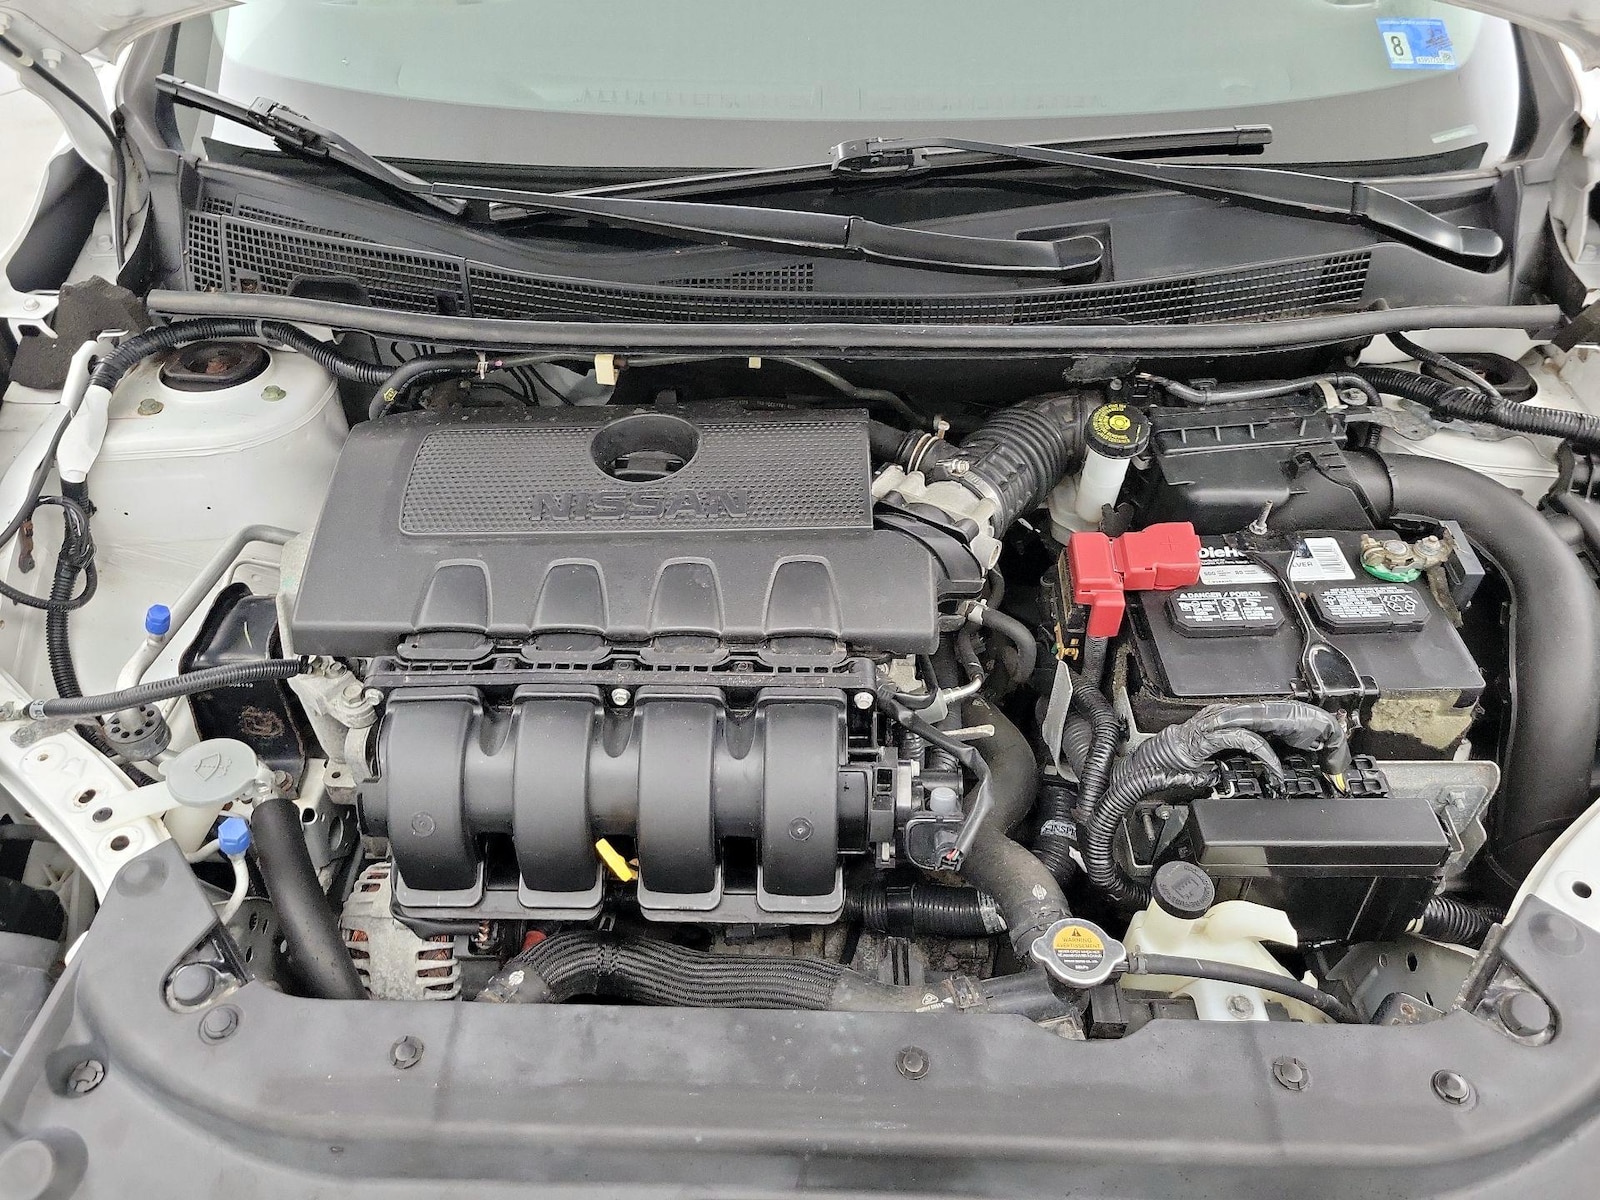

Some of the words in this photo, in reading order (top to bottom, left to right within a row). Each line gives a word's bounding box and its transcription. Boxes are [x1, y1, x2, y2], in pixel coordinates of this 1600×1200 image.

[1390, 35, 1404, 57] 8
[529, 489, 749, 521] NISSAN
[1187, 591, 1221, 599] DANGER
[1229, 590, 1261, 598] POISON
